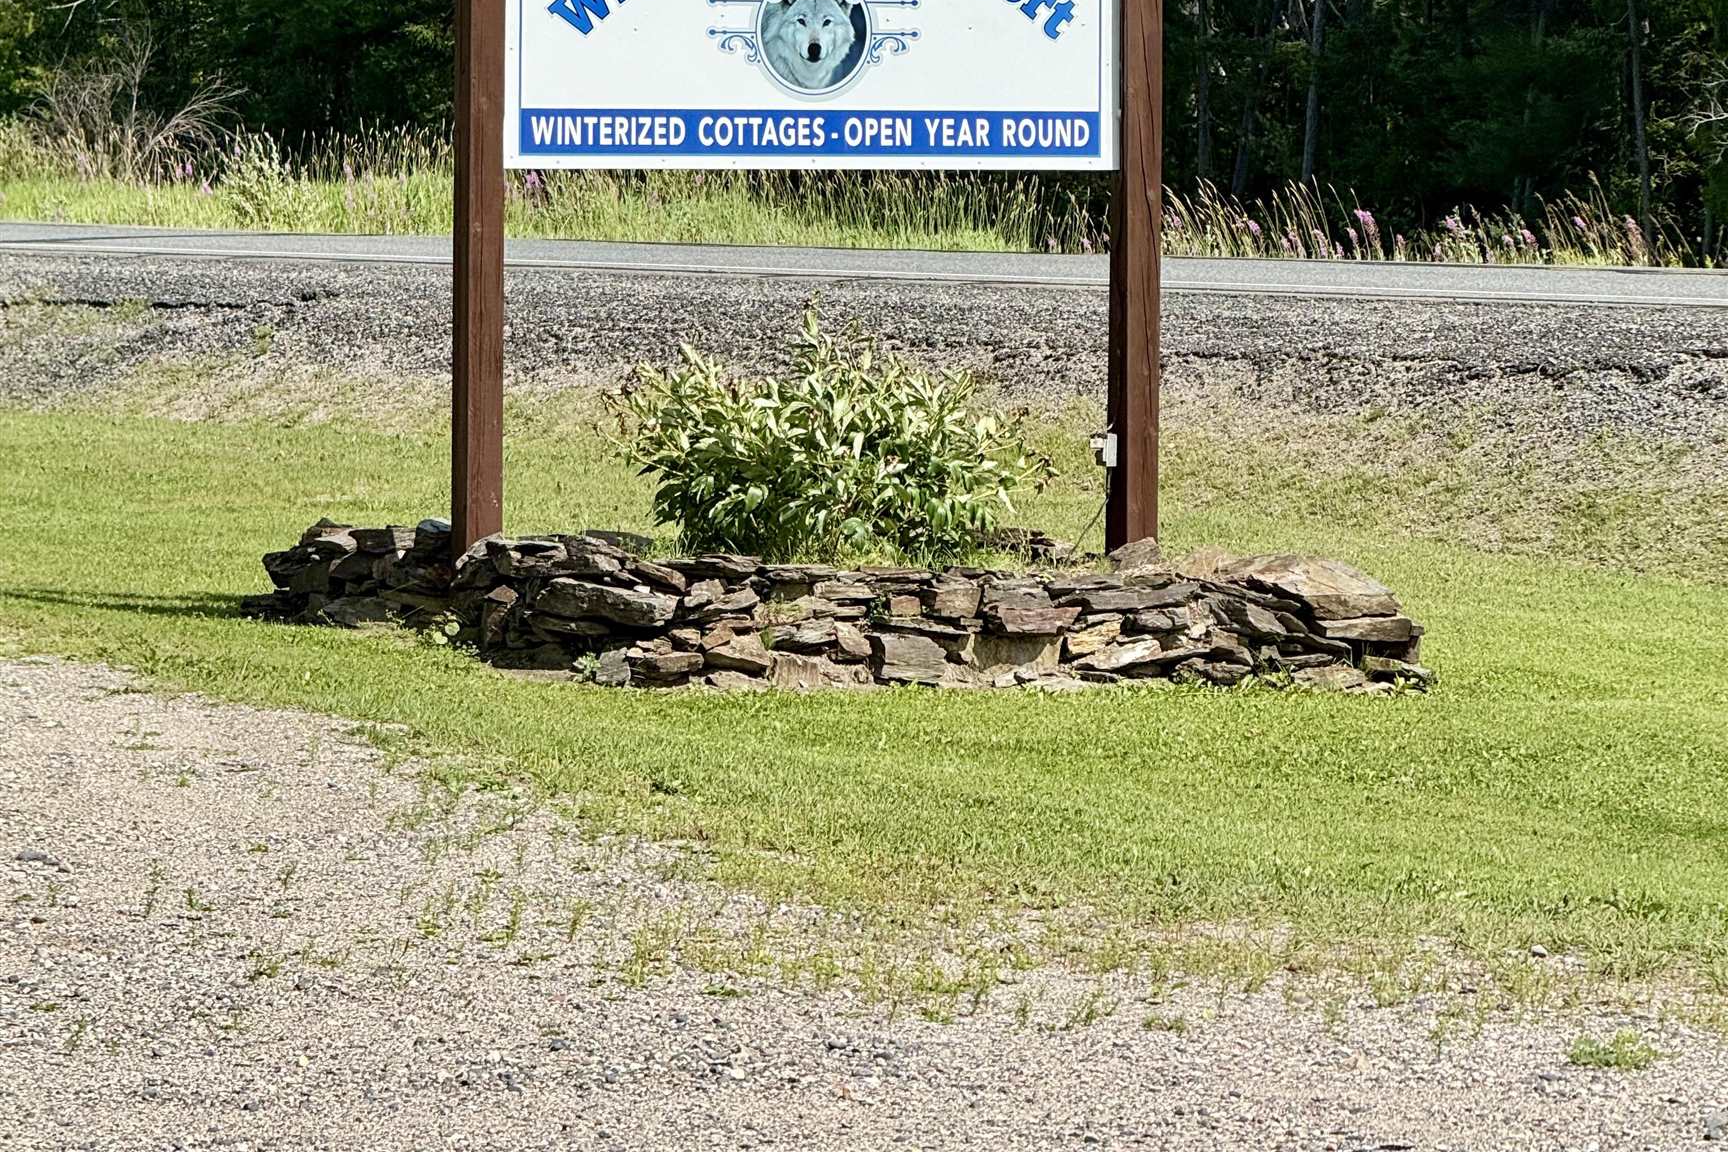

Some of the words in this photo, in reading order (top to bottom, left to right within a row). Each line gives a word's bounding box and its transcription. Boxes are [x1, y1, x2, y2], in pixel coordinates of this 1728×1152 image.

[531, 116, 686, 146] WINTERIZED
[925, 118, 990, 146] YEAR
[1003, 119, 1090, 148] ROUND
